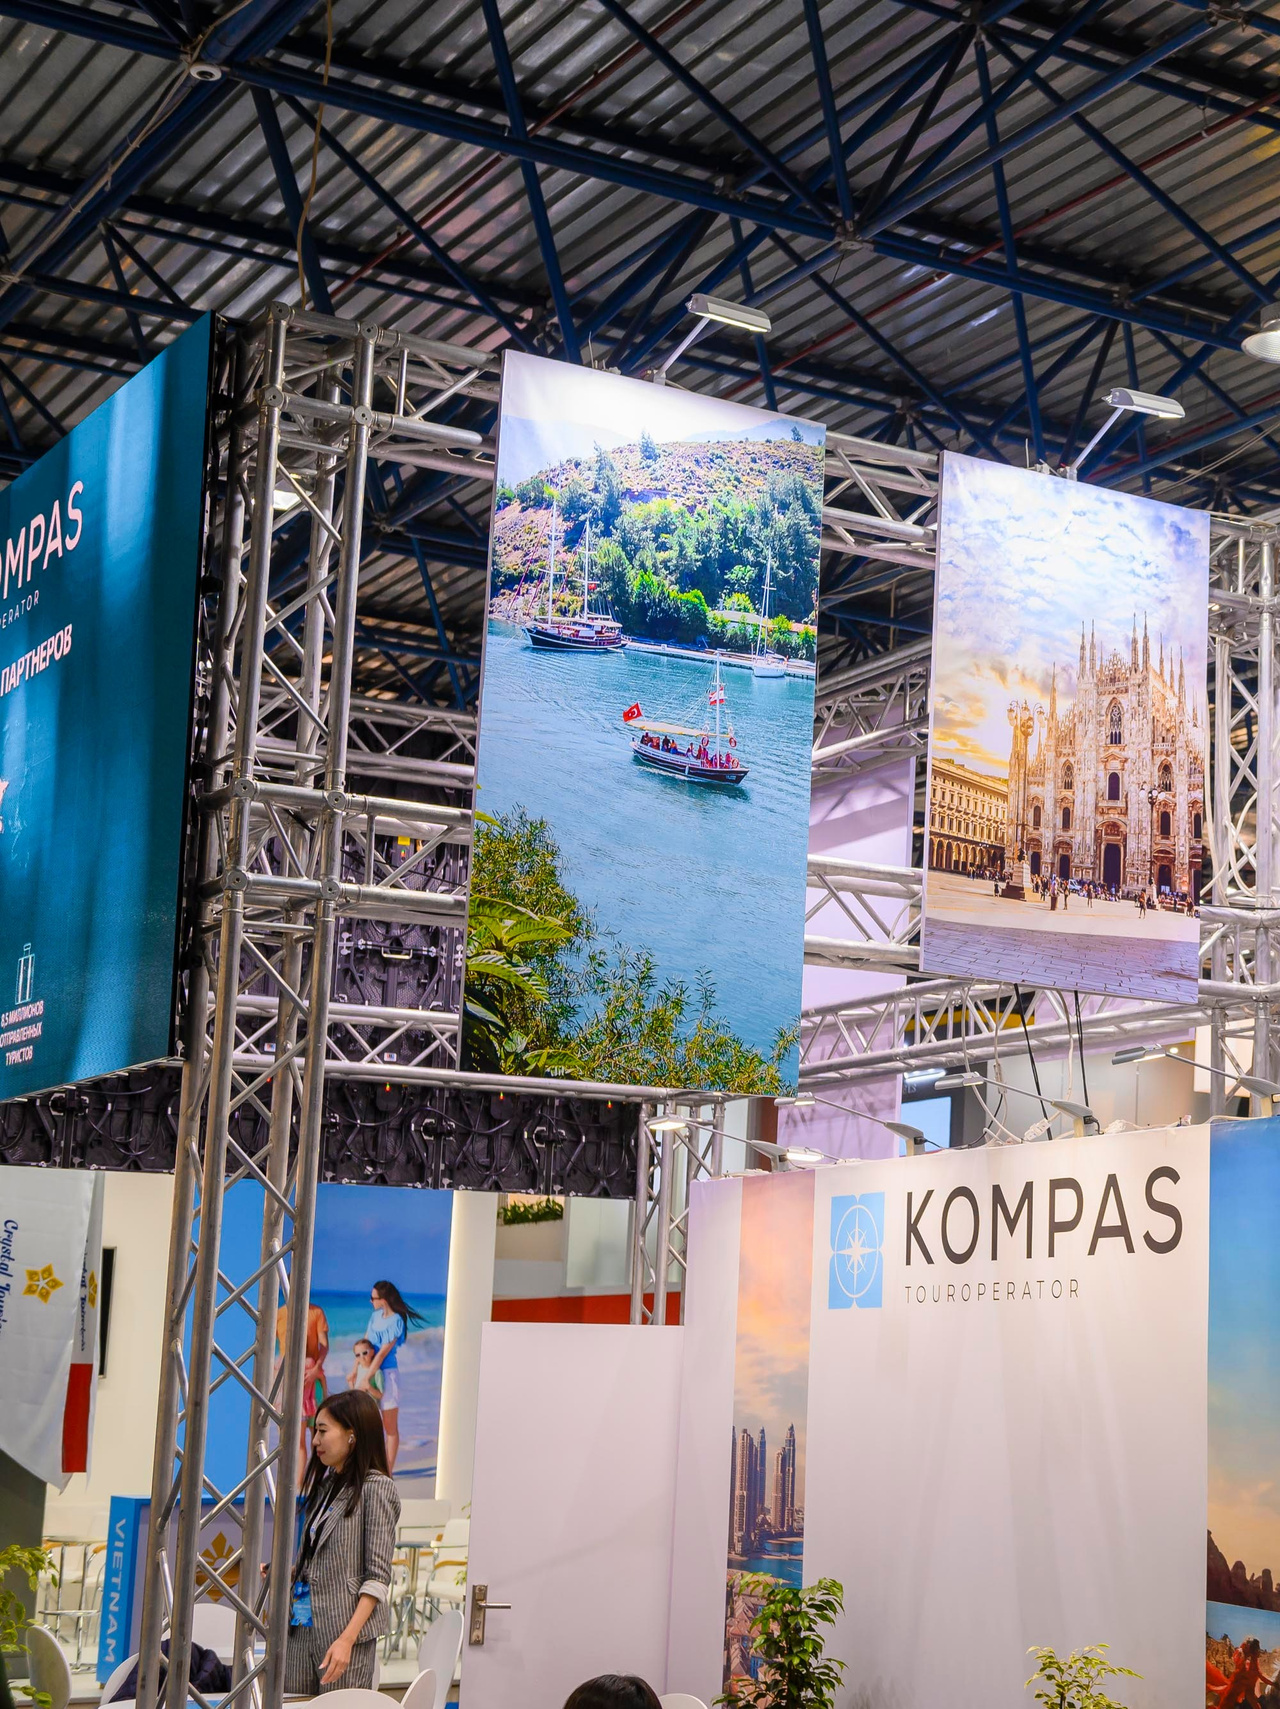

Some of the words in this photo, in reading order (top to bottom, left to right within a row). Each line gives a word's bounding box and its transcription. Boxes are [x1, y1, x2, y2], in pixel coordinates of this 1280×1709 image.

[0, 480, 84, 600] MPAS
[0, 624, 73, 697] ПАРТНЕРОВ
[905, 1165, 1184, 1267] KOMPAS
[904, 1278, 1081, 1305] TOUROPERATOR
[104, 1517, 127, 1664] VIETNAM
